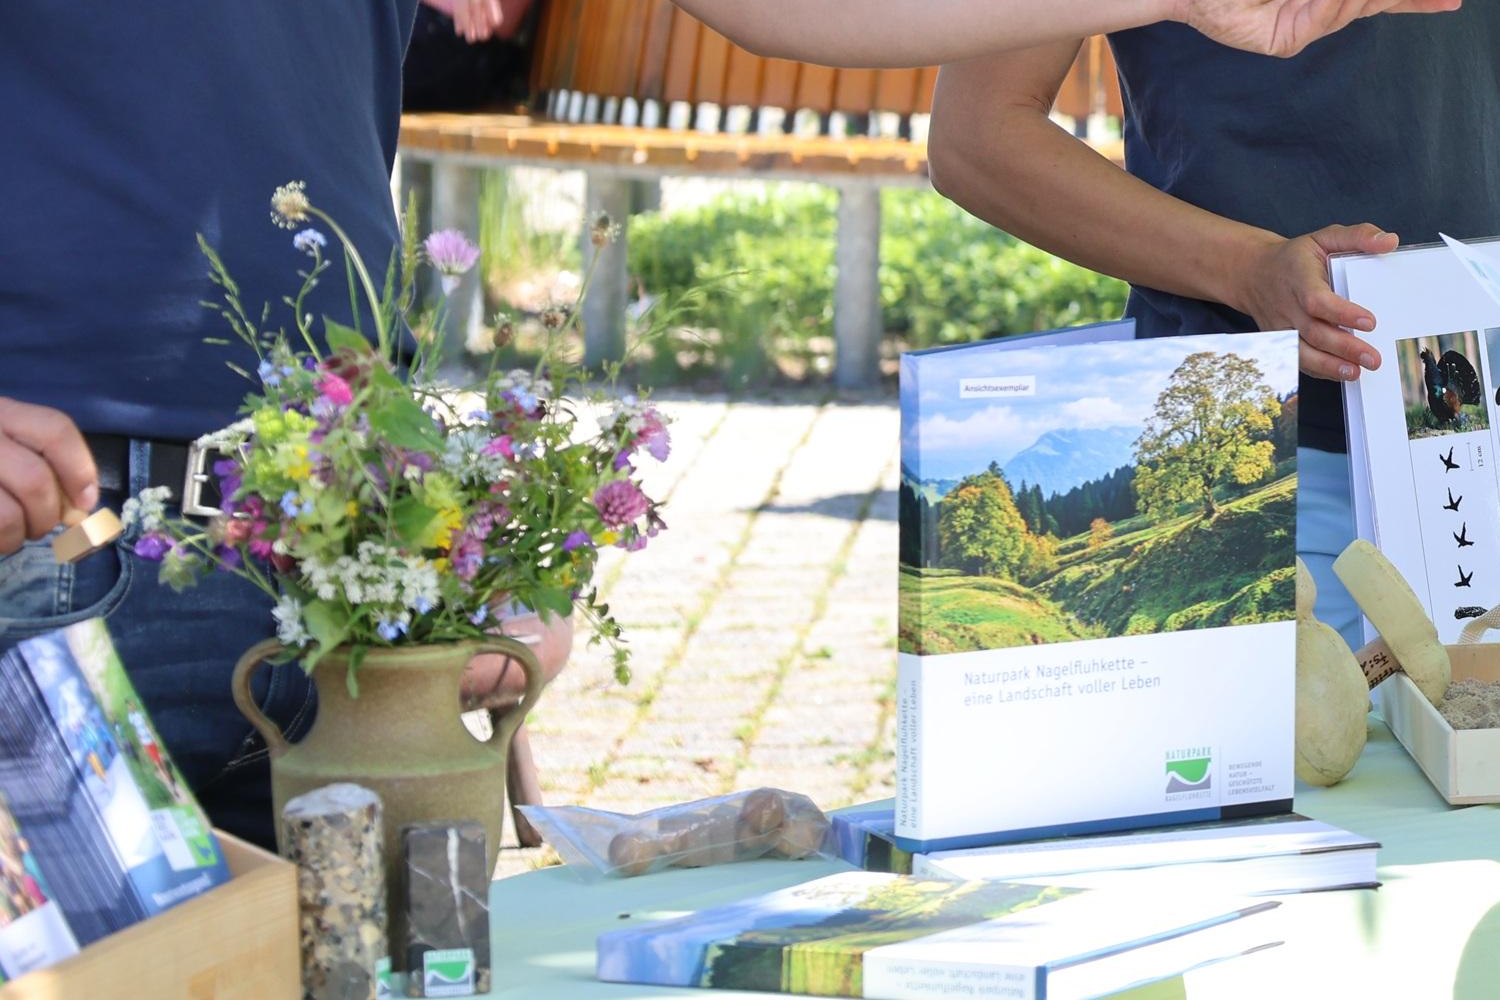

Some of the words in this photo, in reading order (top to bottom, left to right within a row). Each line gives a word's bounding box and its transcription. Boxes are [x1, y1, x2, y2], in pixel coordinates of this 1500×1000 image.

[964, 667, 1030, 686] Naturpark
[1036, 658, 1136, 681] Nagelfluhkette
[963, 692, 993, 707] eine
[999, 681, 1073, 704] Landschaft
[1078, 679, 1116, 695] voller
[1121, 674, 1161, 690] Leben
[1165, 746, 1212, 760] NATURPARK
